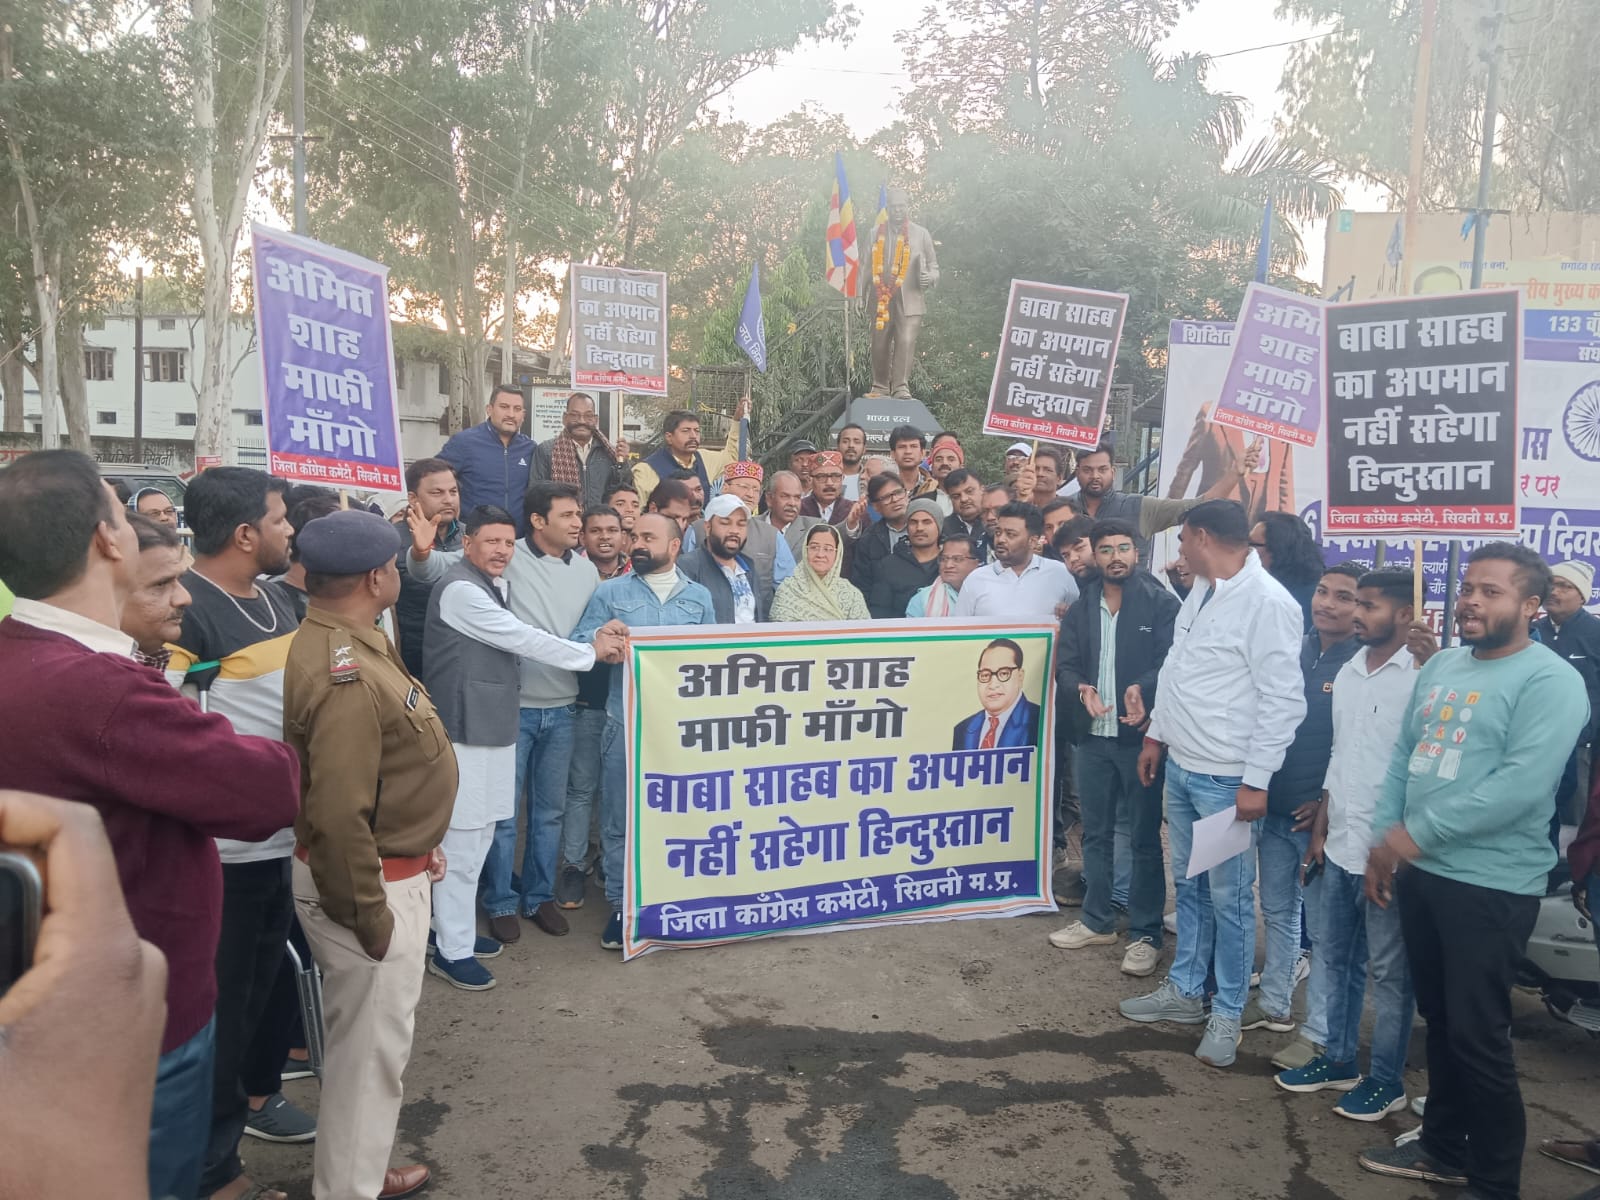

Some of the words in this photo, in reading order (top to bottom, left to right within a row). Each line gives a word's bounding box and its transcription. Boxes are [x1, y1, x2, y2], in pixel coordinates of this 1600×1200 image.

[265, 256, 374, 319] अमित
[580, 275, 615, 294] बाबा
[618, 278, 658, 299] साहब
[578, 299, 600, 317] का
[604, 301, 660, 323] अपमान
[1019, 296, 1062, 321] बाबा
[1065, 302, 1117, 328] साहब
[1253, 302, 1321, 337] अमि
[1550, 315, 1581, 332] 133
[288, 313, 362, 360] शाह
[583, 321, 613, 342] नहीं
[615, 322, 657, 346] सहेगा
[1010, 326, 1037, 348] का
[1040, 330, 1113, 360] अपमान
[1259, 334, 1320, 365] शाह
[1337, 319, 1409, 352] बाबा
[1417, 312, 1507, 347] साहब
[586, 344, 655, 371] हिन्दुस्तान
[1010, 354, 1048, 381] नहीं
[1049, 359, 1102, 389] सहेगा
[281, 362, 374, 411] माफी
[1243, 361, 1316, 396] माफी
[1333, 370, 1376, 399] का
[1386, 361, 1509, 397] अपमान
[1006, 382, 1092, 418] हिन्दुस्तान
[866, 414, 890, 423] भारत
[892, 414, 911, 423] रत्न
[990, 415, 1009, 427] जिला
[1342, 405, 1403, 446] नहीं
[1409, 404, 1500, 443] सहेगा
[272, 455, 297, 474] जिला
[1348, 455, 1494, 502] हिन्दुस्तान
[1535, 475, 1561, 499] पर
[1330, 509, 1359, 524] जिला
[1401, 508, 1438, 526] कमेटी,
[1485, 512, 1513, 525] म.प्र.
[678, 653, 815, 698] अमित
[827, 657, 915, 690] शाह
[678, 704, 791, 752] माफी
[644, 770, 734, 813] बाबा
[743, 760, 841, 807] साहब
[848, 756, 897, 795] का
[907, 747, 1035, 791] अपमान
[665, 820, 743, 877] नहीं
[750, 816, 849, 871] सहेगा
[858, 807, 1014, 865] हिन्दुस्तान
[660, 904, 727, 936] जिला
[815, 878, 888, 914] कमेटी,
[894, 867, 963, 904] सिवनी
[968, 870, 1019, 891] म.प्र.
